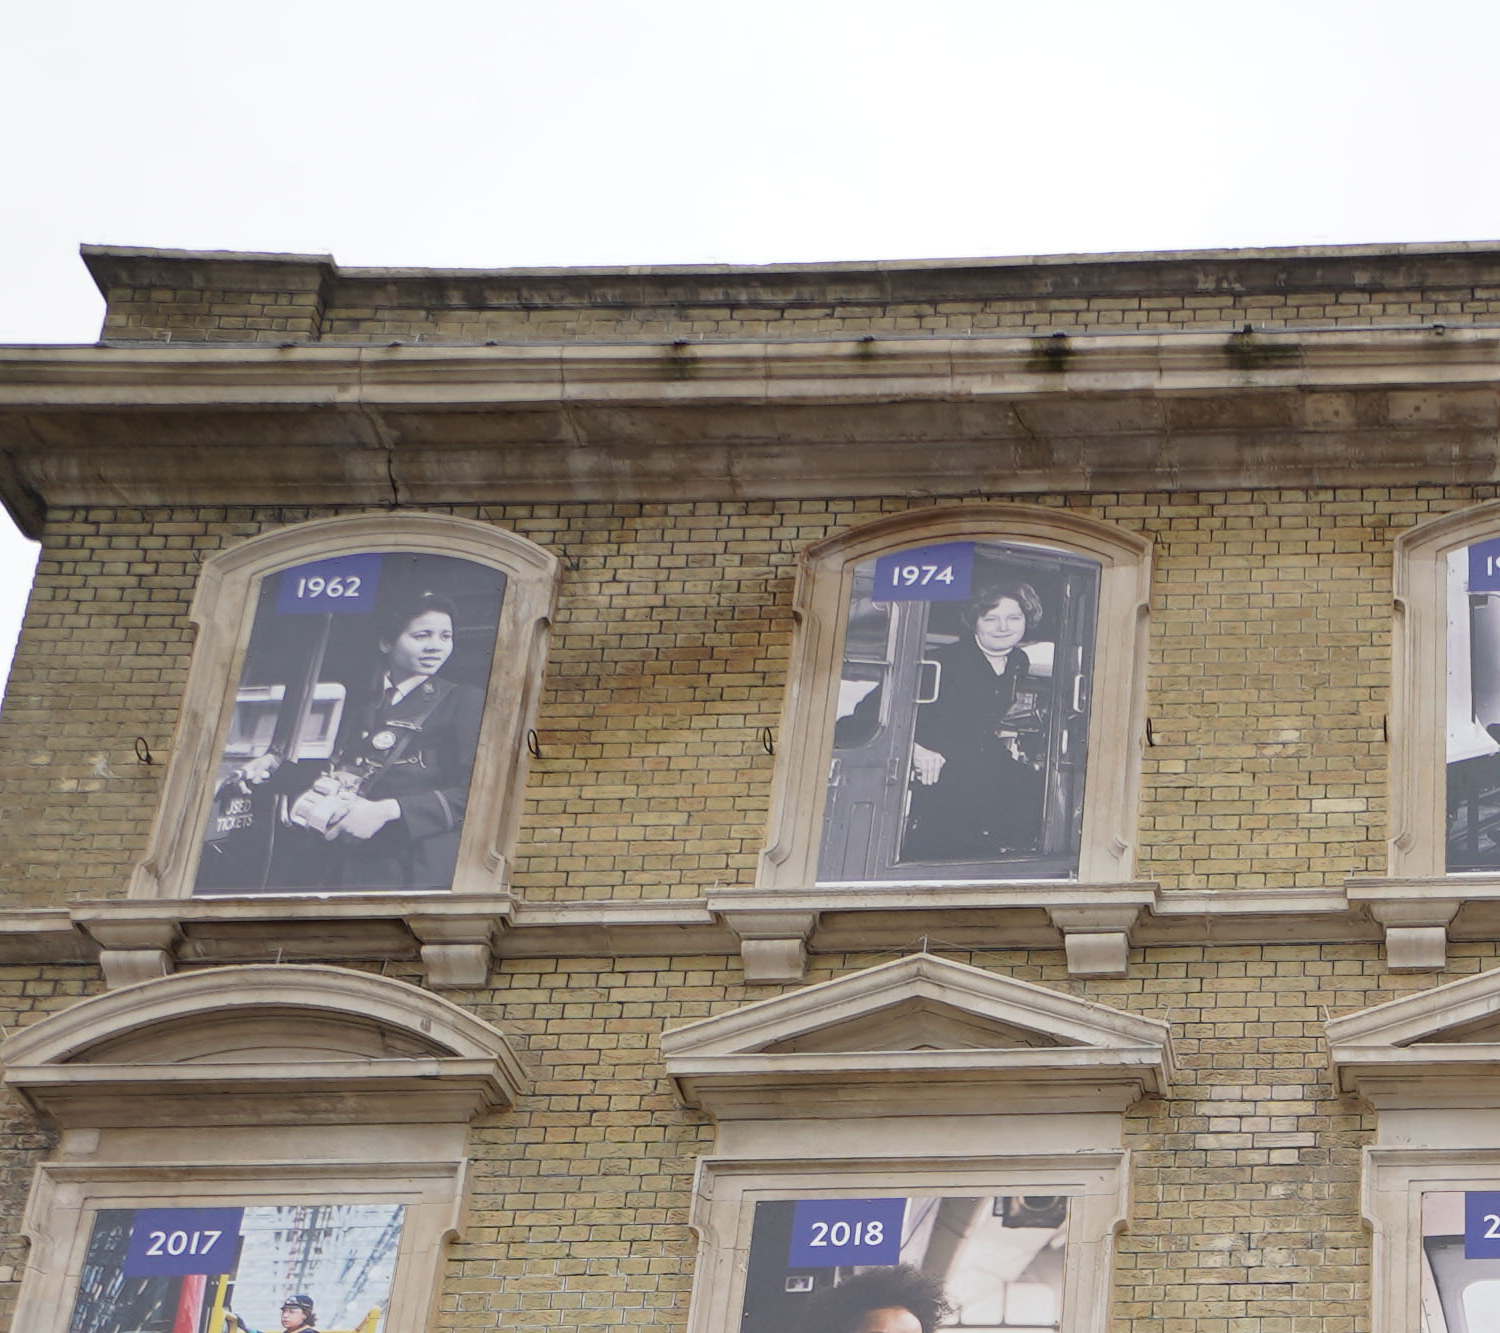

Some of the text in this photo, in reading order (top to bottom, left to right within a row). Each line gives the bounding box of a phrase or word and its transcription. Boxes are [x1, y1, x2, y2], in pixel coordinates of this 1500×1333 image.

[297, 576, 361, 598] 1962
[892, 565, 955, 586] 1974
[147, 1231, 221, 1255] 2017
[810, 1221, 883, 1246] 2018
